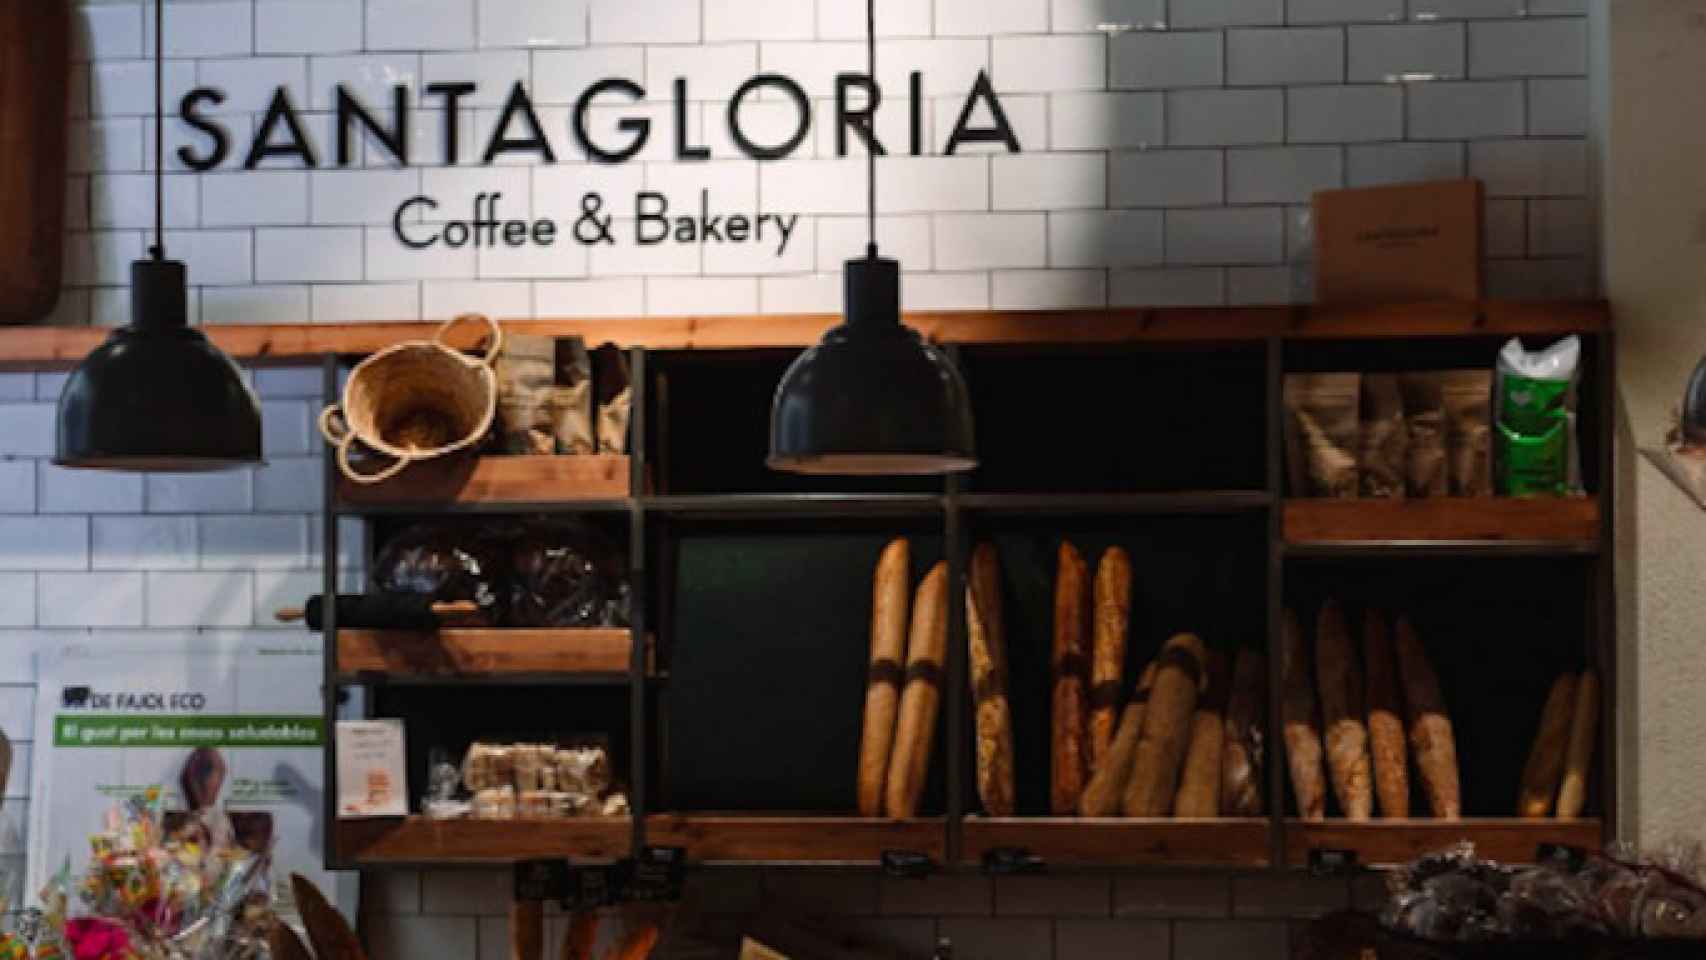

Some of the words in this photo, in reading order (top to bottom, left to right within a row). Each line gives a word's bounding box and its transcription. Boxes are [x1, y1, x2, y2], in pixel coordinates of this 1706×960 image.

[176, 69, 1022, 172] SANTAGLORIA
[393, 191, 557, 250] Coffee
[573, 192, 616, 245] &
[634, 187, 799, 257] Bakery
